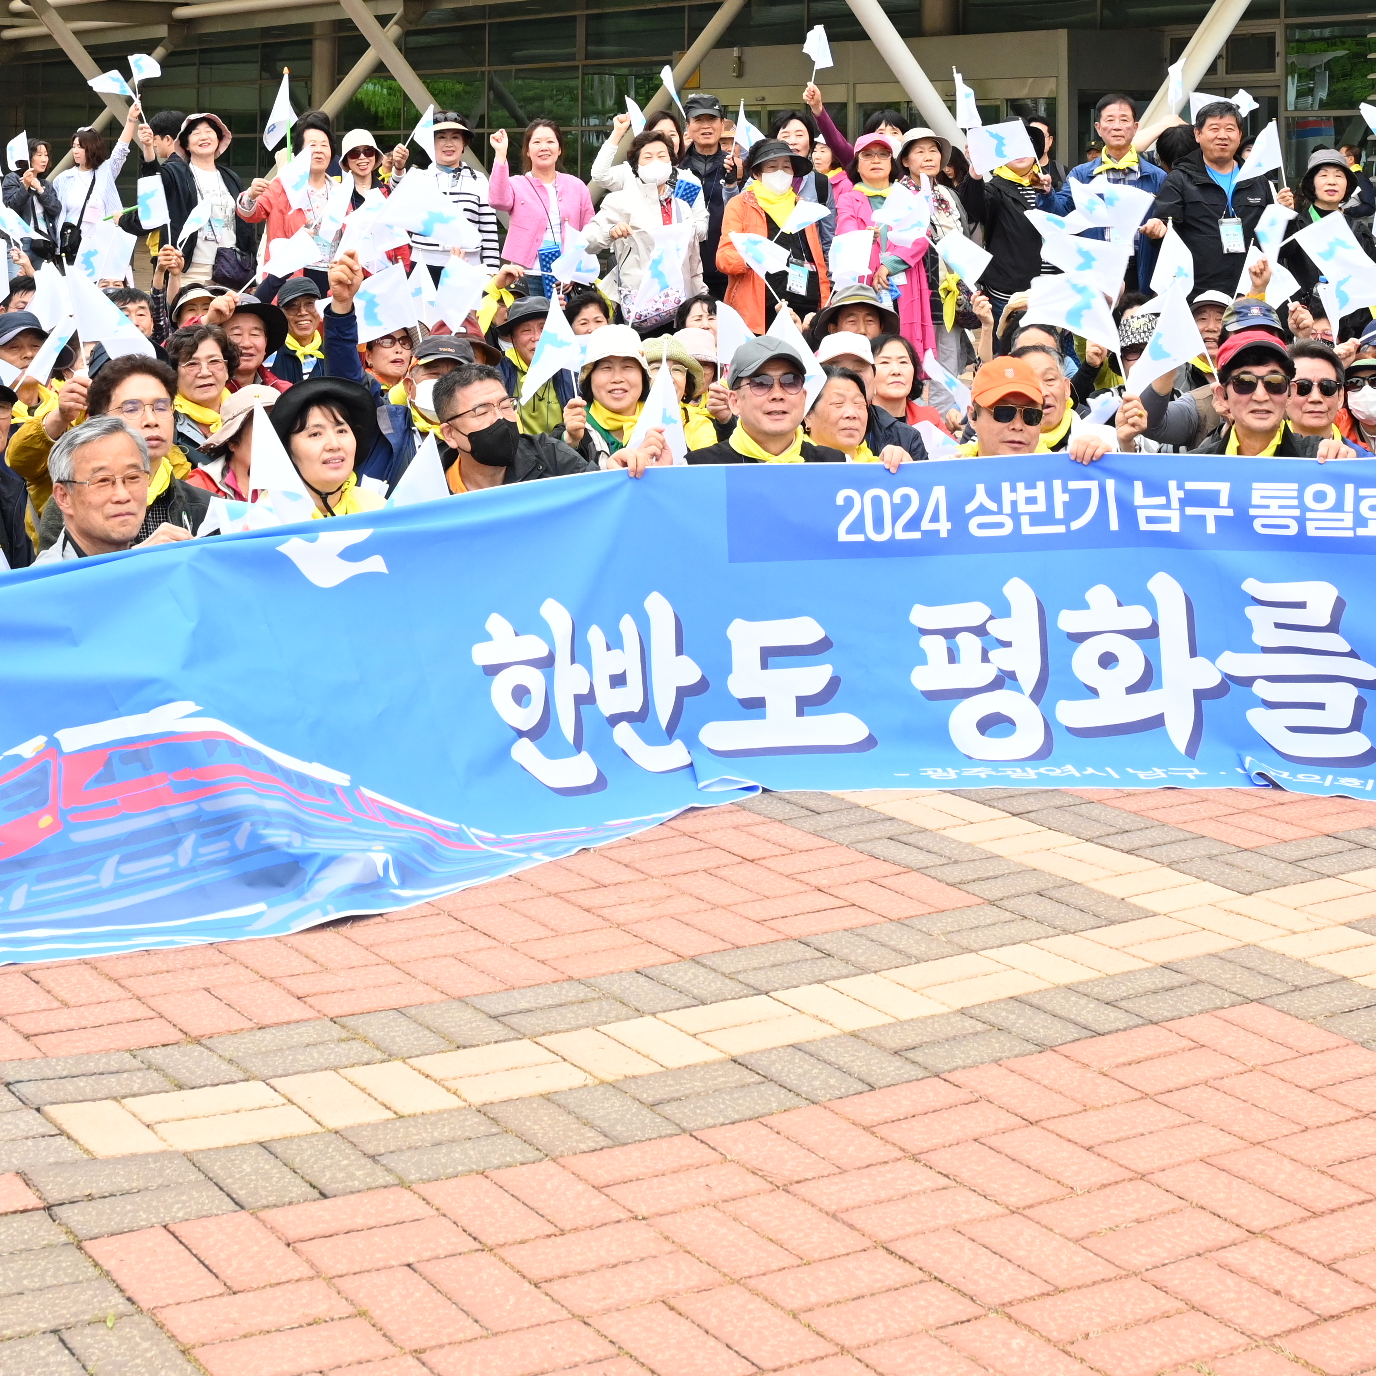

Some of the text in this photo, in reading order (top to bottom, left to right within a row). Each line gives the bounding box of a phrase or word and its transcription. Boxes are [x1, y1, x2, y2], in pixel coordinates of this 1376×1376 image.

[835, 485, 952, 542] 2024
[965, 479, 1120, 538] 상반기
[1133, 479, 1235, 534] 남구
[471, 591, 874, 794] 한반도
[918, 765, 1121, 780] 광주광역시
[1125, 767, 1208, 780] 남구
